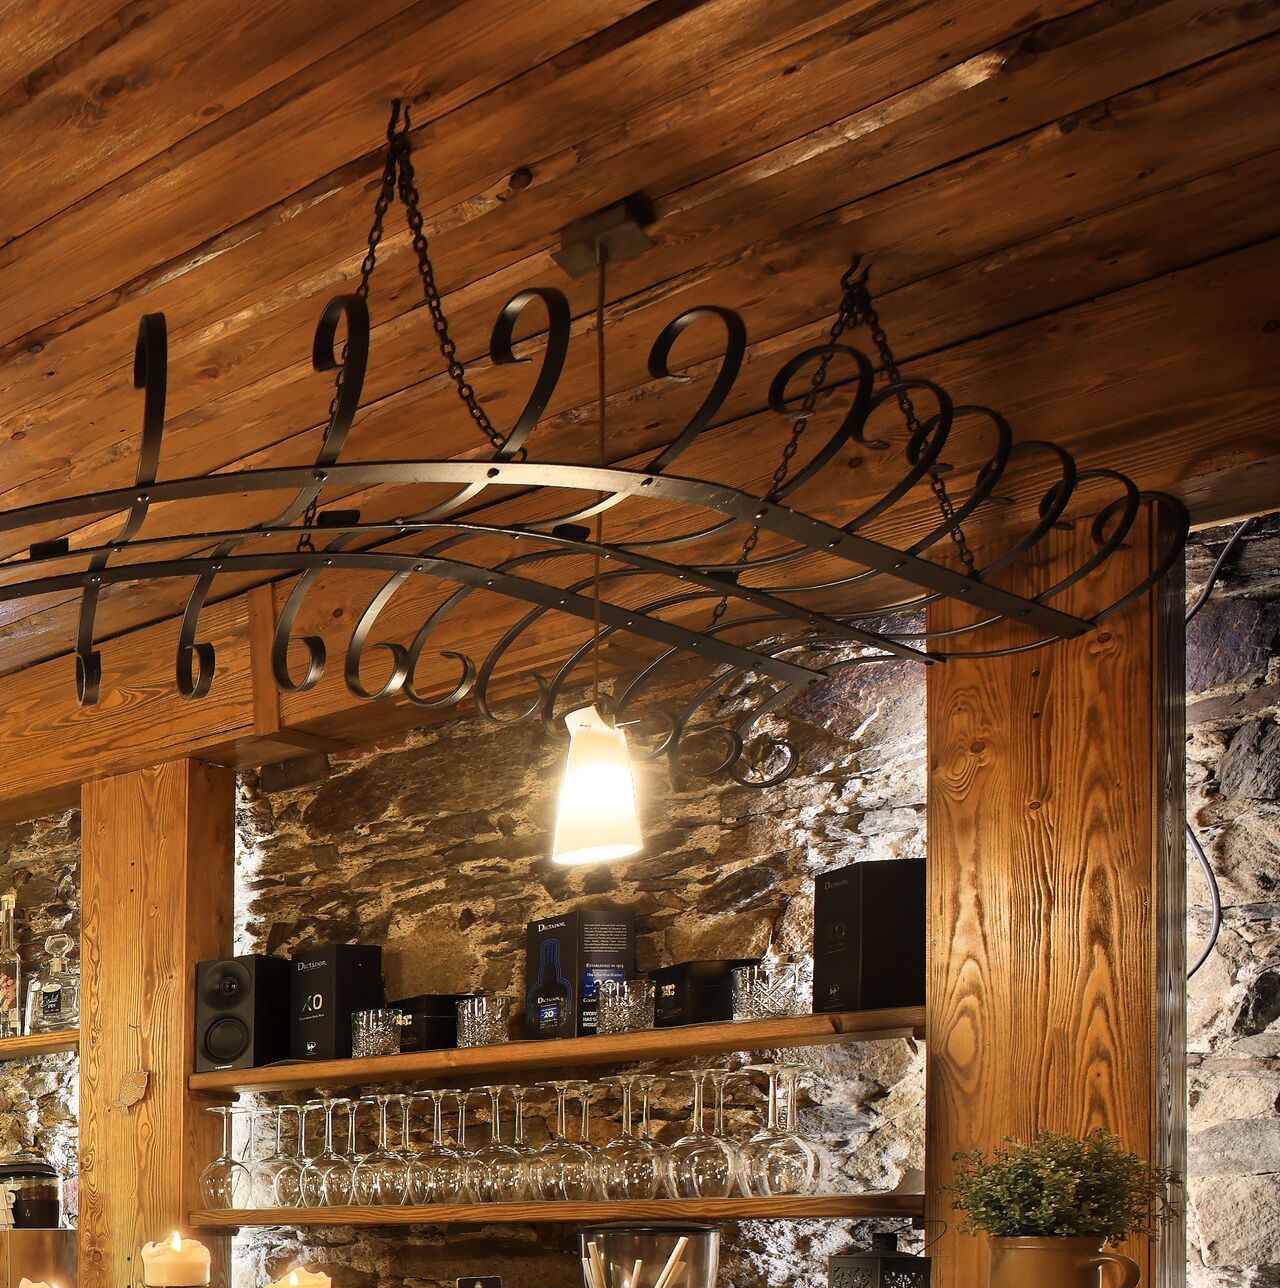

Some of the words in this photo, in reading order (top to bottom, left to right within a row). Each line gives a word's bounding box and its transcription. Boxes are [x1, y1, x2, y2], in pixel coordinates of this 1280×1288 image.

[538, 922, 566, 932] DICTADOR
[297, 961, 327, 971] DICTADOR
[543, 1010, 554, 1019] 20
